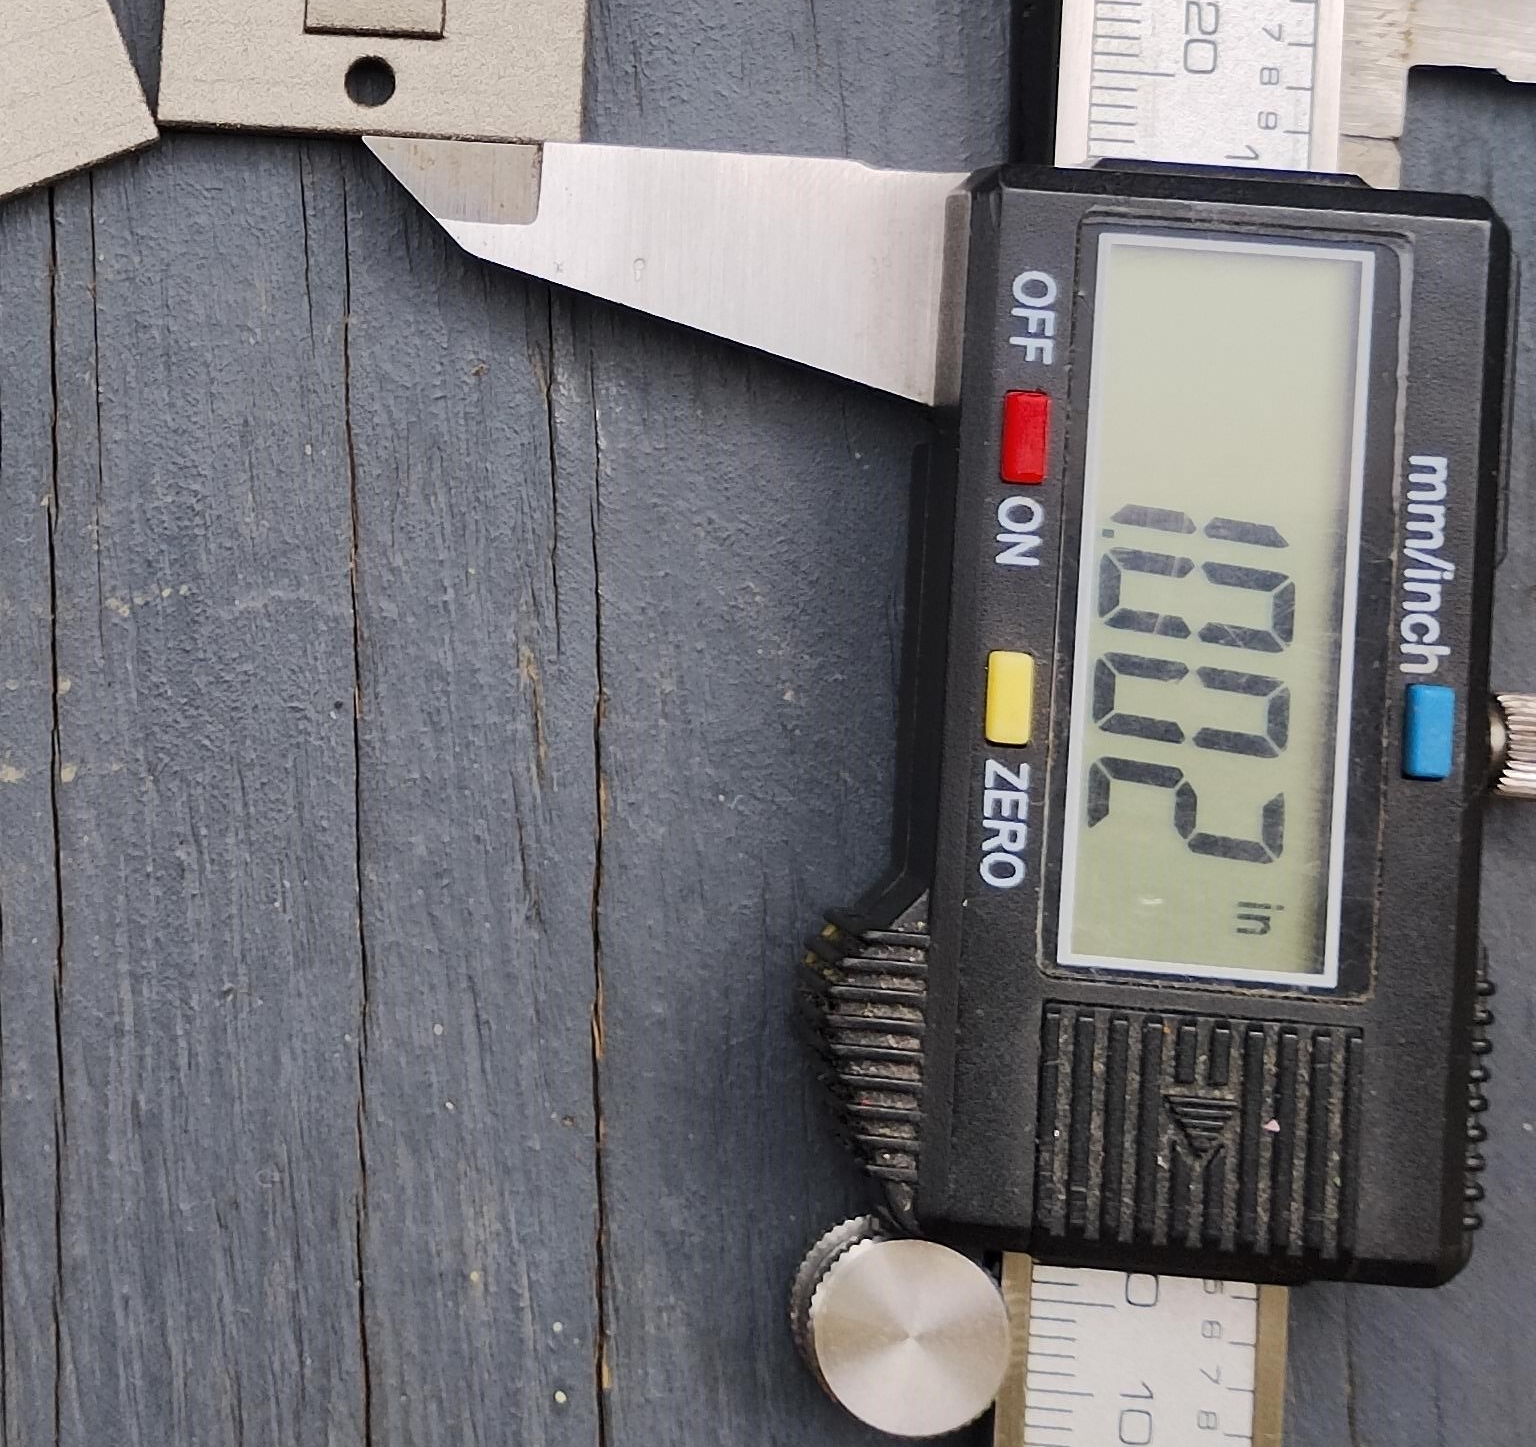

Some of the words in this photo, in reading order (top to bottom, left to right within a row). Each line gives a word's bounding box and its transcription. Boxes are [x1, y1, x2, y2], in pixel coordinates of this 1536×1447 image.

[1183, 0, 1220, 74] 20
[1262, 23, 1283, 43] 7
[1259, 66, 1280, 86] 8
[1257, 111, 1278, 130] 9
[1009, 270, 1057, 366] OFF
[996, 496, 1045, 568] ON
[1400, 455, 1450, 675] mm/inch
[1086, 503, 1296, 864] 1.002
[1237, 901, 1284, 936] in
[979, 759, 1031, 890] ZERO
[1201, 1320, 1222, 1339] 6
[1200, 1365, 1221, 1384] 7
[1119, 1380, 1154, 1445] 10
[1197, 1410, 1218, 1430] 8
